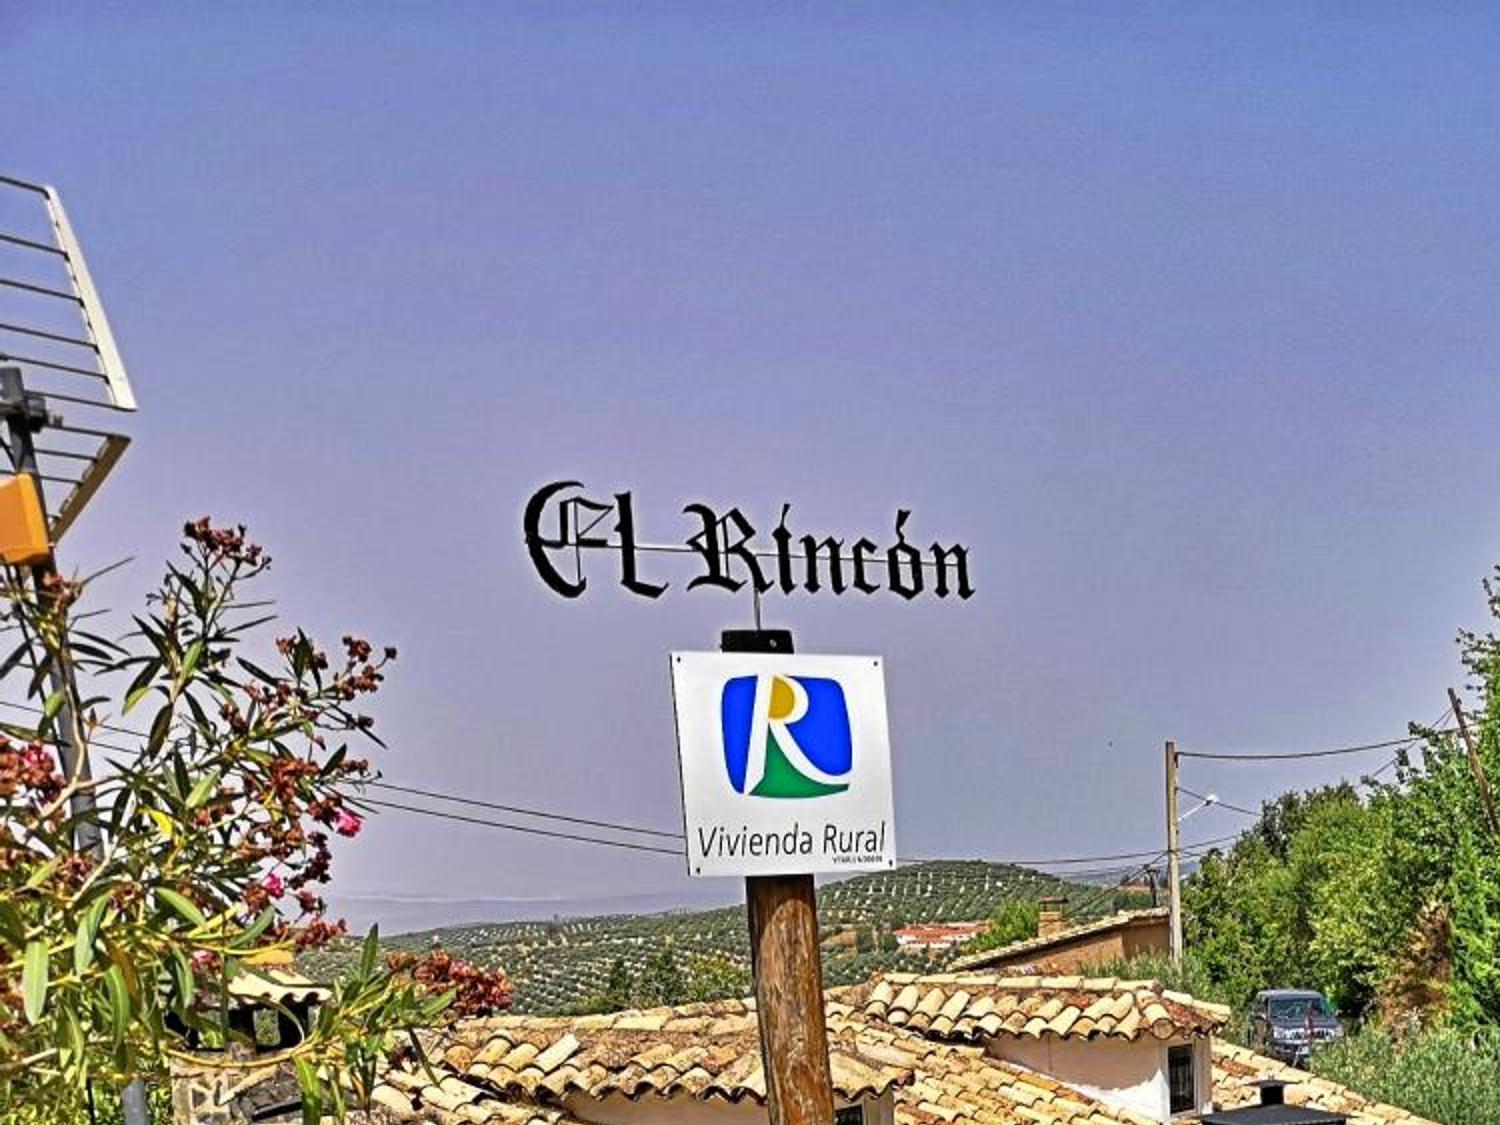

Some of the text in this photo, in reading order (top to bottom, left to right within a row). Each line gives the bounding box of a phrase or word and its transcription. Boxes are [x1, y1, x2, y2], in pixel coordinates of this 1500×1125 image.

[682, 503, 976, 601] Rincón
[698, 821, 886, 857] Vivienda Rural
